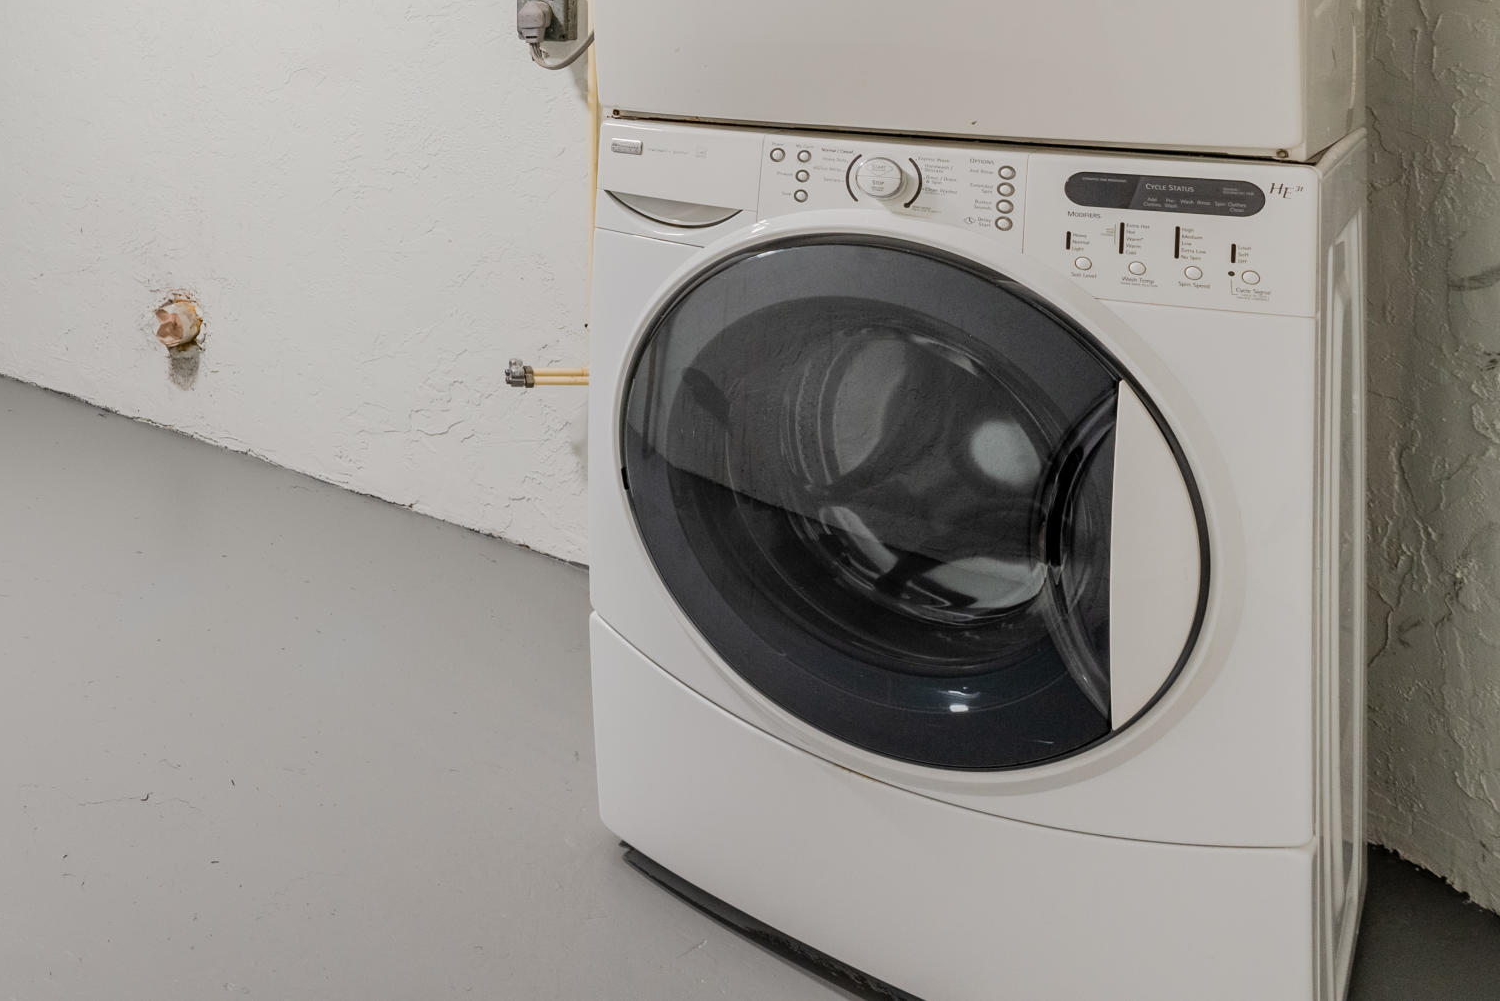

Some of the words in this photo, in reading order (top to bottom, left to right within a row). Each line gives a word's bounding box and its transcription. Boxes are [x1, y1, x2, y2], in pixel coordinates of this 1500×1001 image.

[1145, 183, 1167, 191] CYCLE
[1168, 184, 1195, 193] STATUS
[1067, 210, 1101, 219] MODIFIERS
